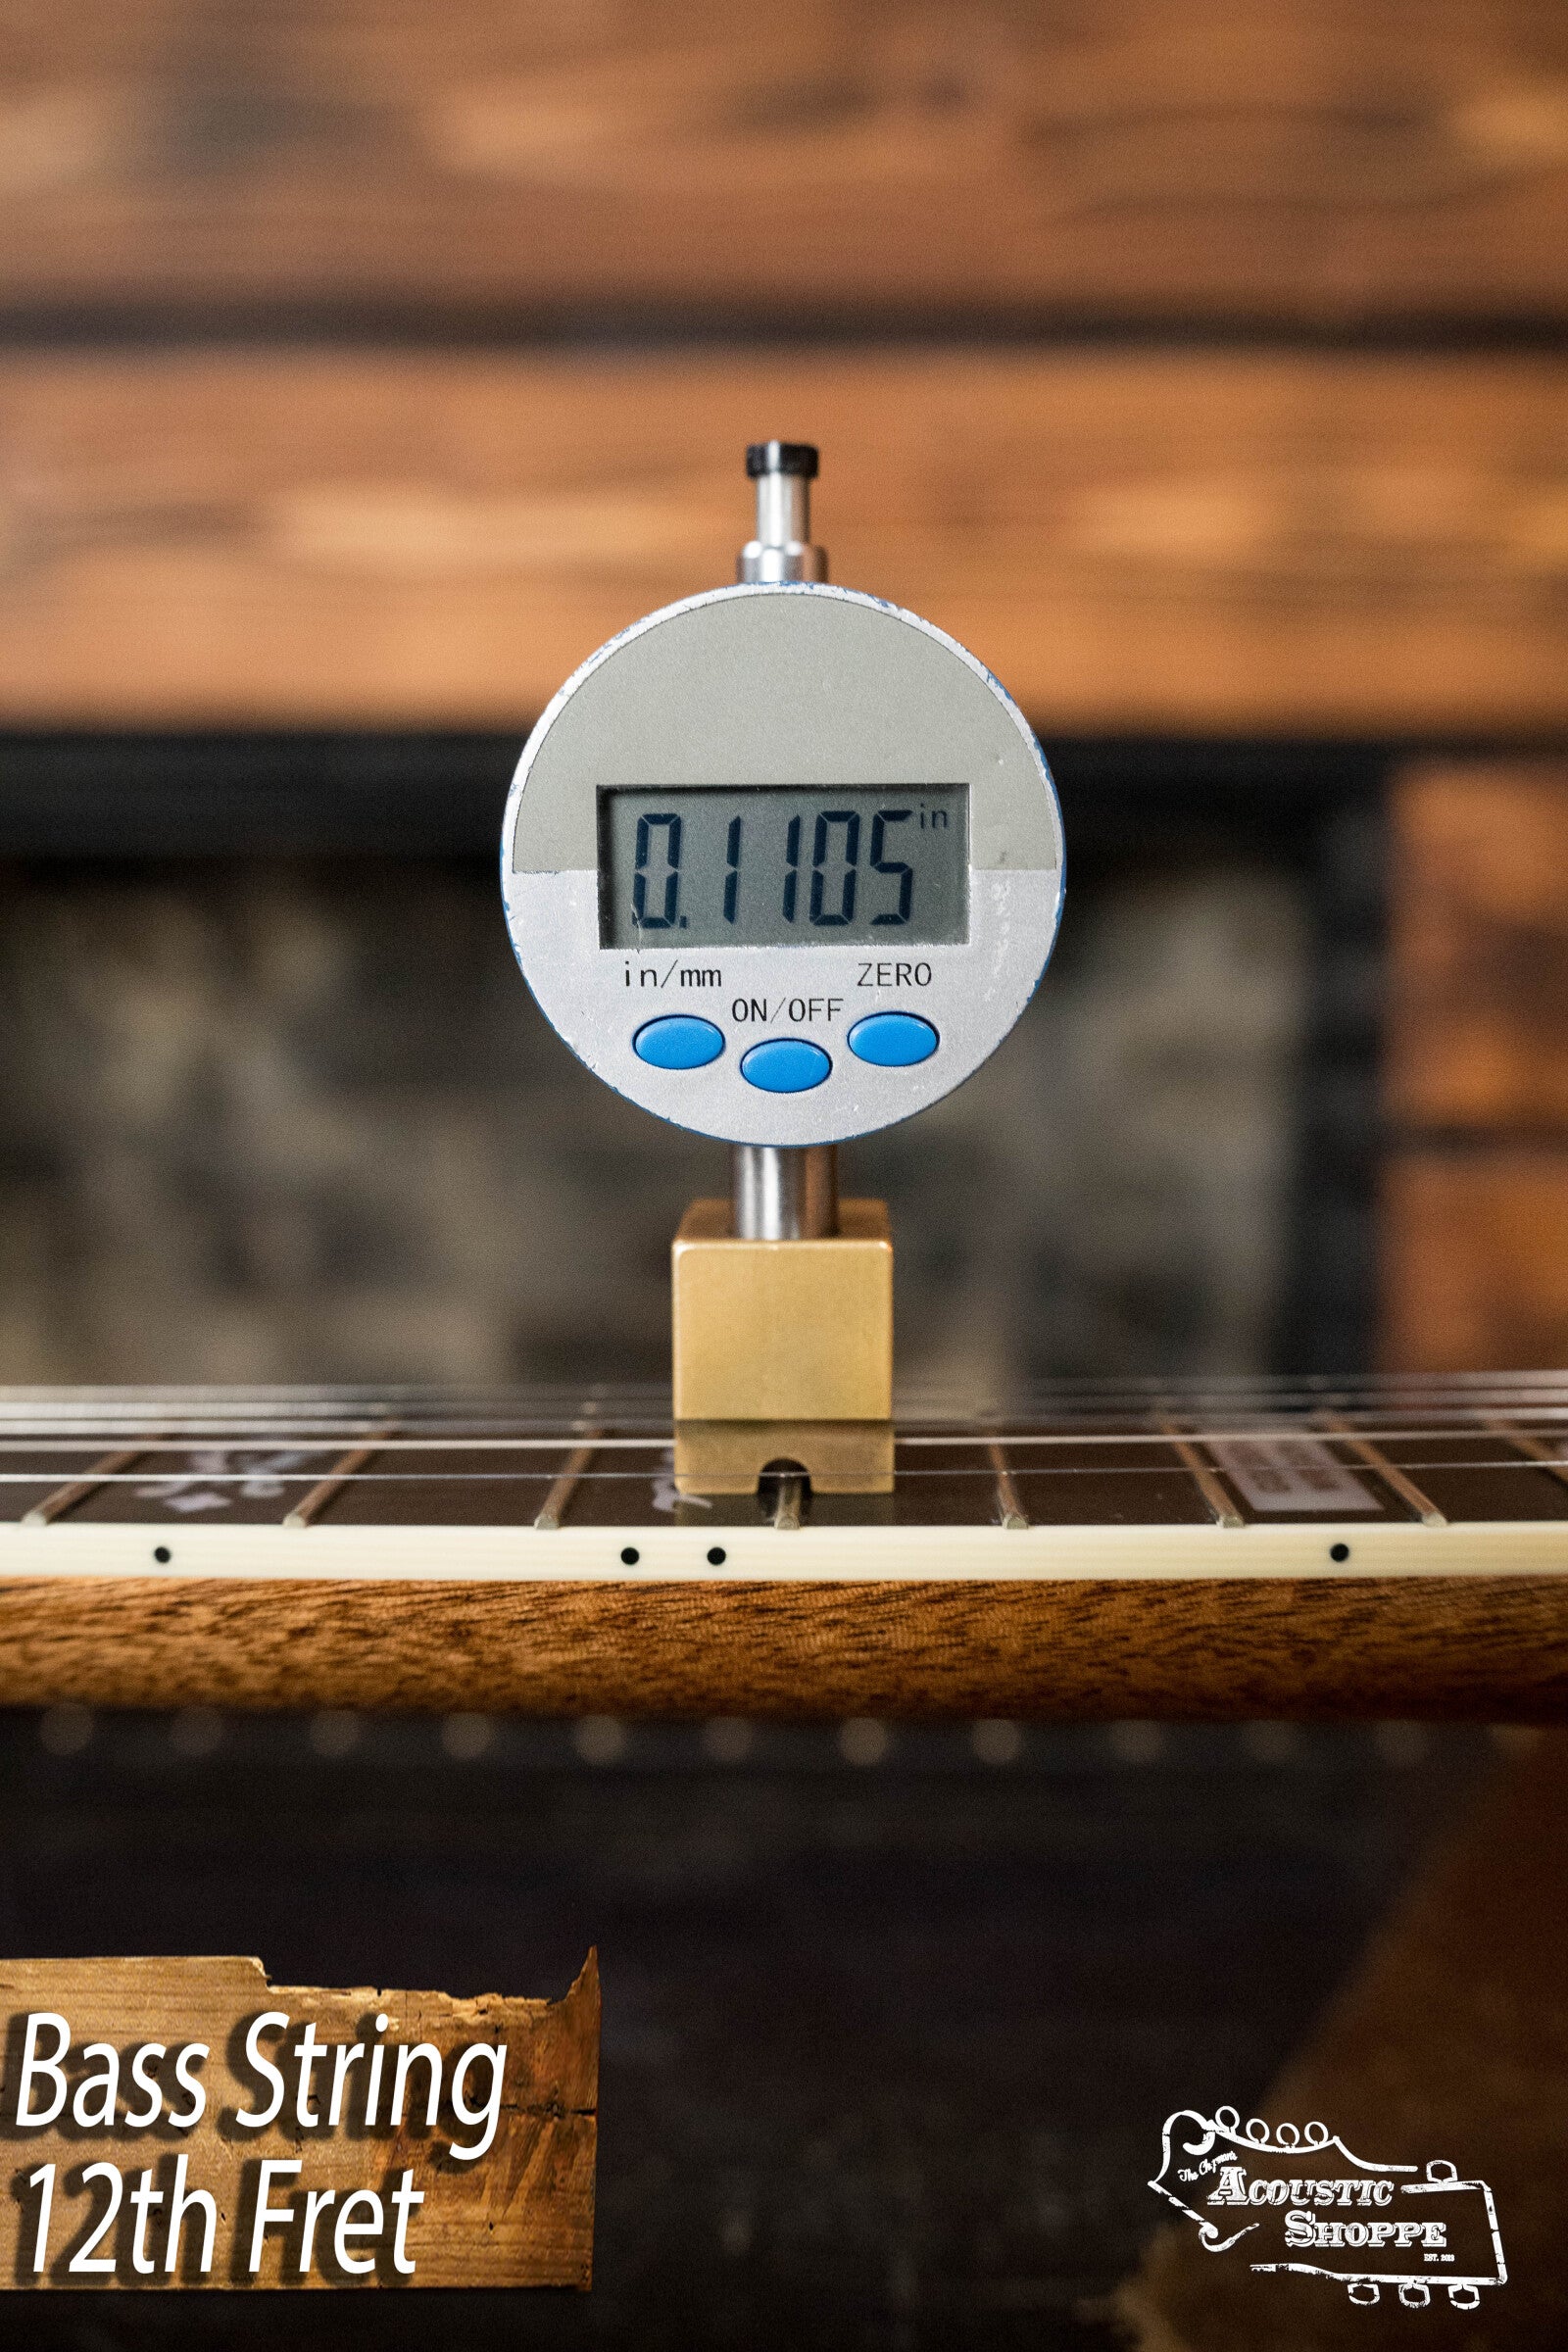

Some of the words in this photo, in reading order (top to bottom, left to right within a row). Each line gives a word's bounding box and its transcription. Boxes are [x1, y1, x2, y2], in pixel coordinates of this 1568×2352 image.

[631, 809, 913, 929] 0.1105
[919, 803, 950, 830] in
[624, 958, 723, 988] in/mm
[857, 961, 933, 988] ZERO
[731, 998, 845, 1024] ON/OFF
